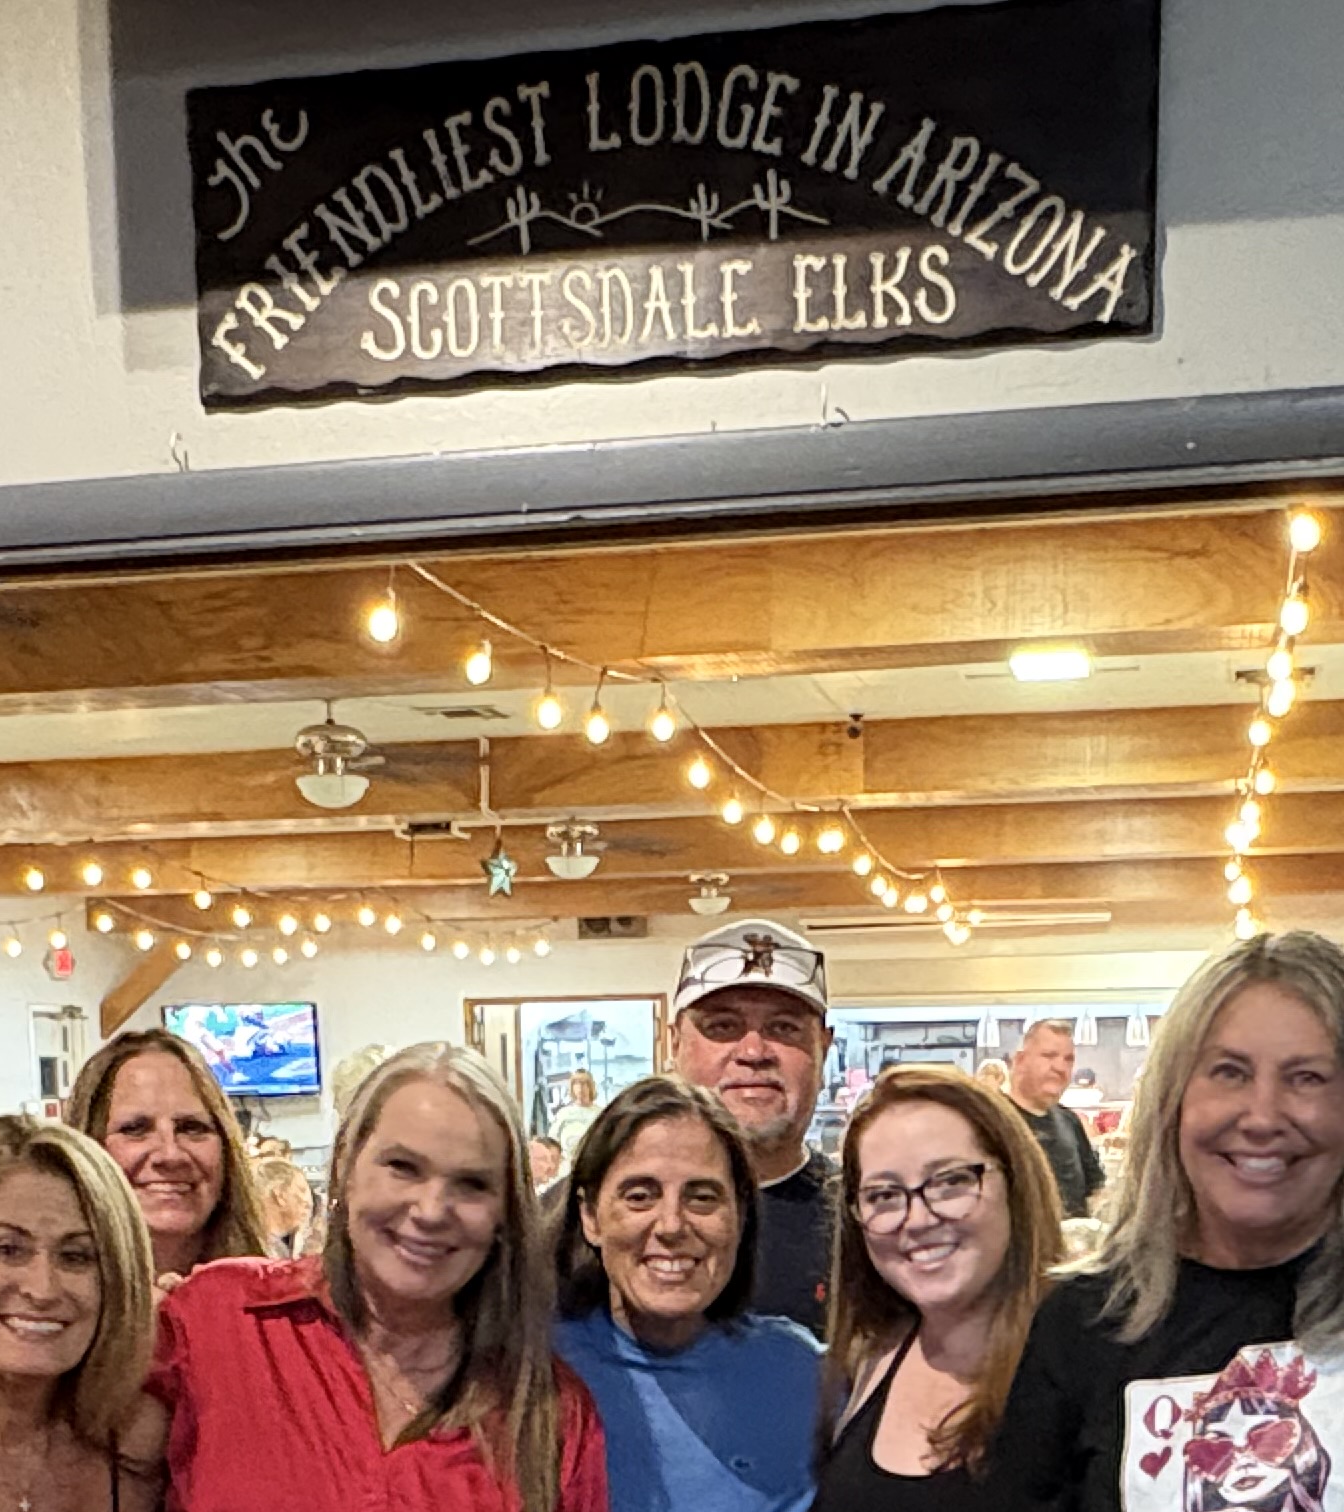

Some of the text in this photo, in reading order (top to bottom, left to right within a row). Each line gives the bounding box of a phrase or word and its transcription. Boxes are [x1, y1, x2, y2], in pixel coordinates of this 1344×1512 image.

[211, 61, 1138, 380] FRIENDLIEST LODGE IN ARIZONA
[360, 244, 957, 361] SCOTTSDALE ELKS
